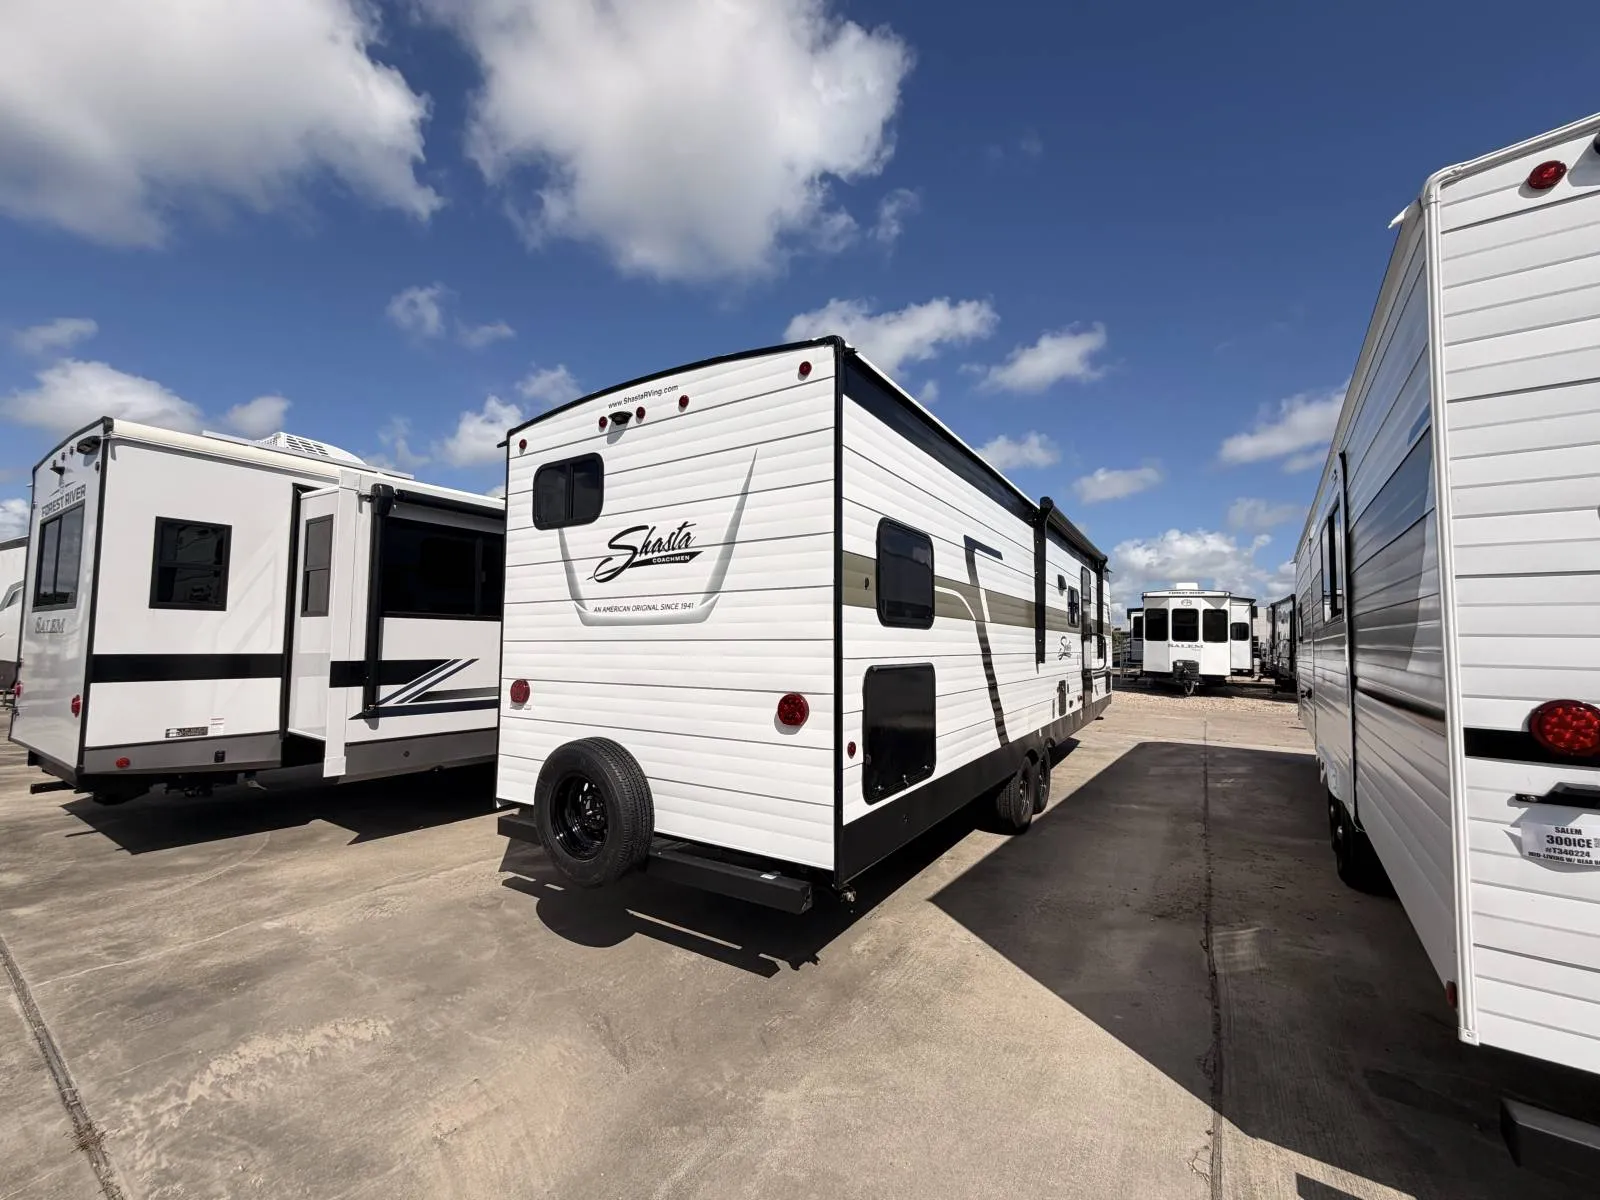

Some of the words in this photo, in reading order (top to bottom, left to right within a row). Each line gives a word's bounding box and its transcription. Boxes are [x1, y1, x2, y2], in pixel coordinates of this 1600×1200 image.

[608, 384, 679, 409] www.ShastaRVing.com
[41, 497, 64, 517] FOREST
[65, 484, 86, 505] RIVER
[586, 521, 697, 583] Shasta
[652, 555, 690, 564] COACHMEN
[602, 605, 631, 613] AMERICAN
[631, 604, 659, 612] ORIGINAL
[660, 602, 679, 611] SINCE
[681, 602, 694, 610] 1941
[35, 616, 66, 634] SALEM
[1555, 827, 1582, 835] SALEM
[1545, 848, 1590, 857] #T340224
